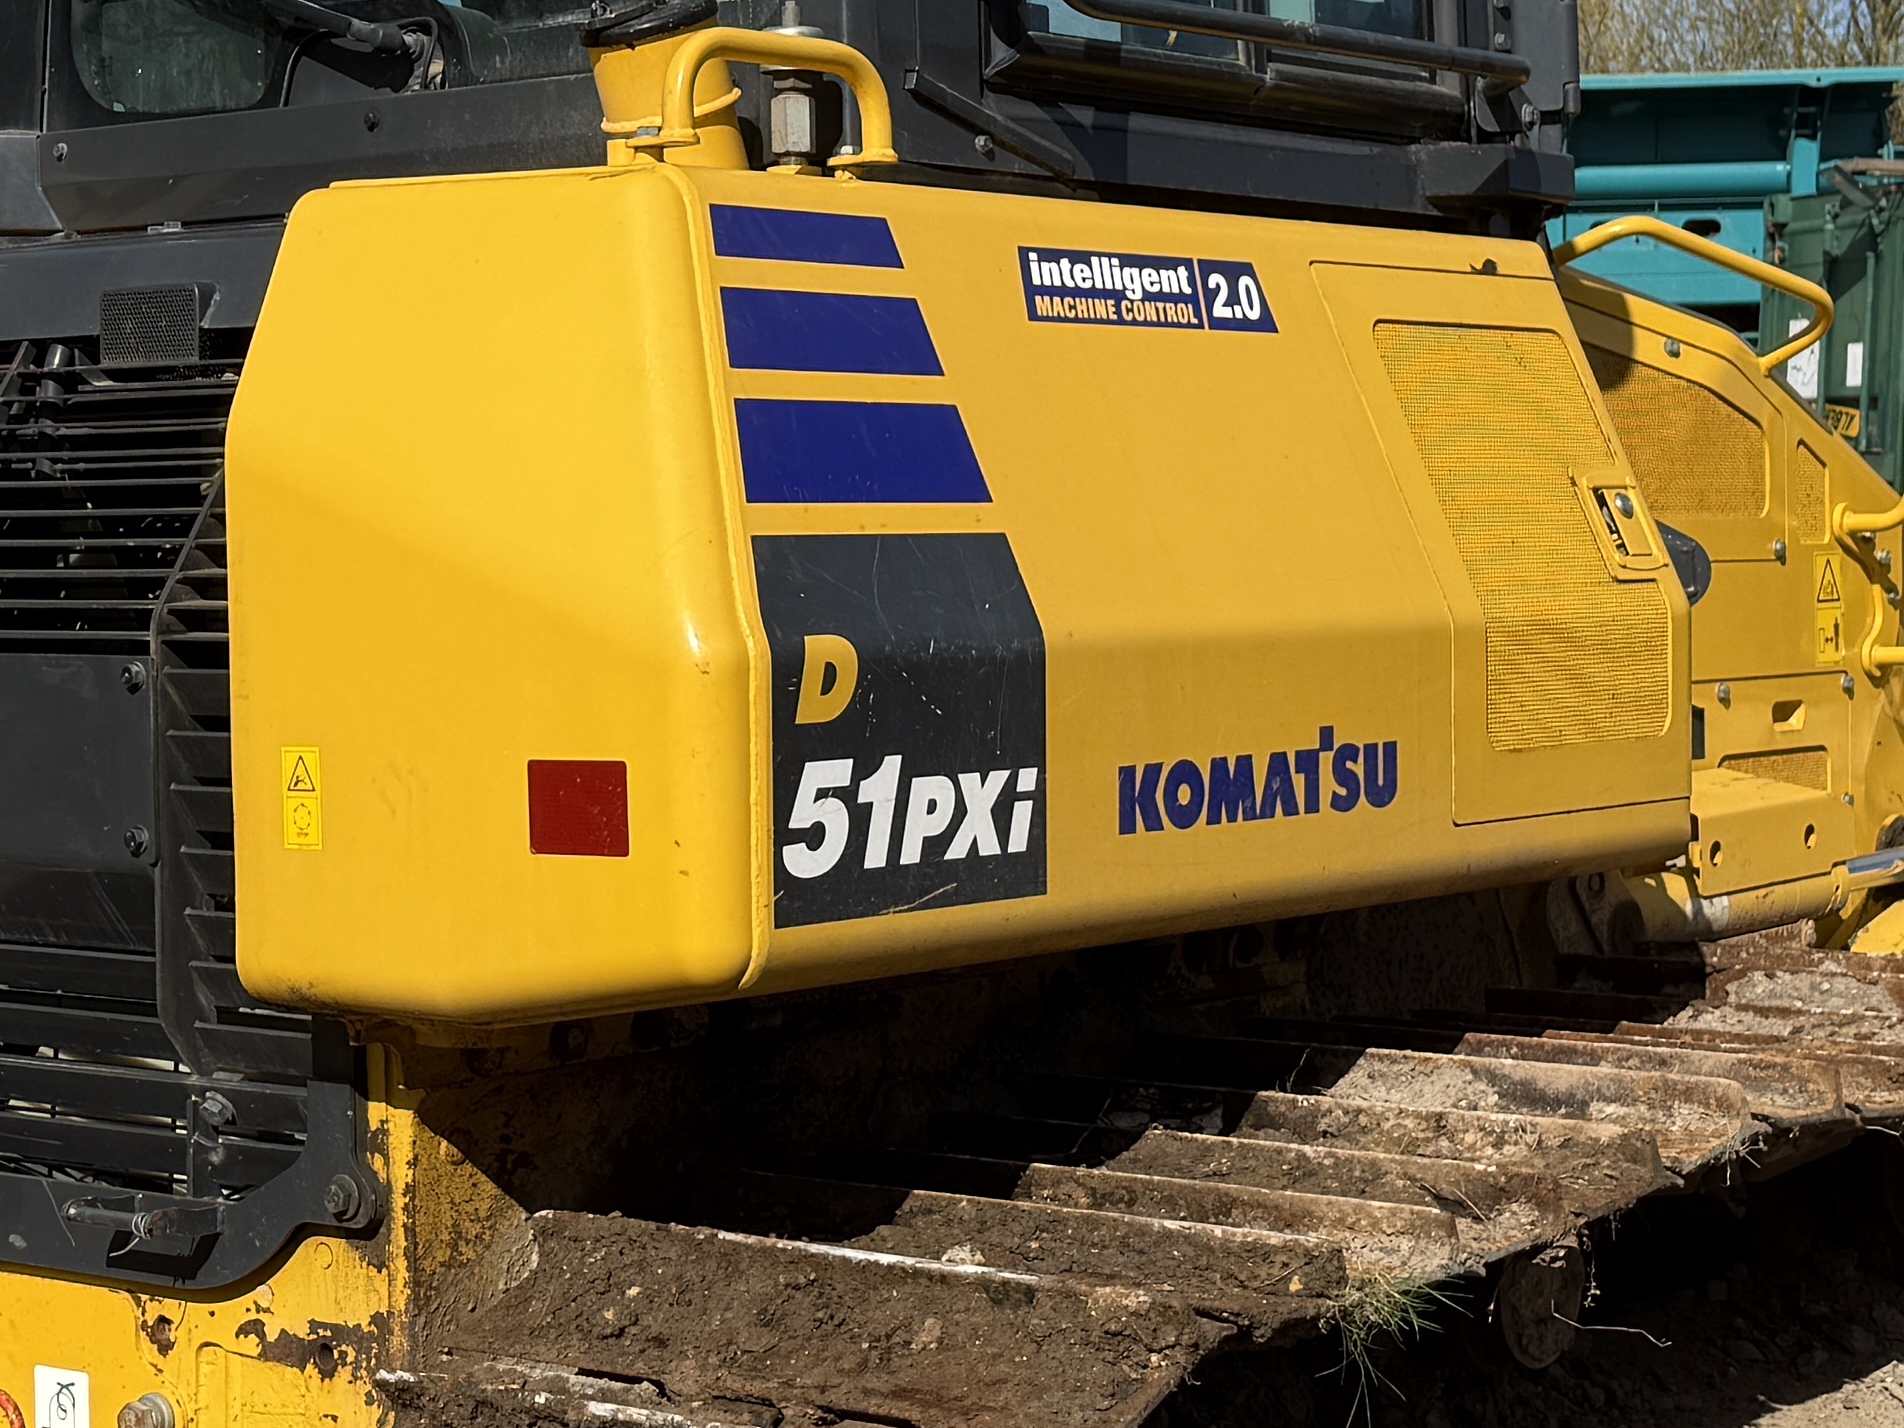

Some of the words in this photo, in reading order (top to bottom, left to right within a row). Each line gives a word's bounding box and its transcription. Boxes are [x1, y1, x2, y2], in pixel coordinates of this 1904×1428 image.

[1028, 252, 1192, 300] intelligent
[1034, 295, 1118, 320] MACHINE
[1121, 300, 1199, 324] CONTROL
[1207, 273, 1262, 321] 2.0
[795, 634, 859, 725] D
[1118, 725, 1397, 836] KOMATSU
[782, 754, 1038, 879] 51PXi
